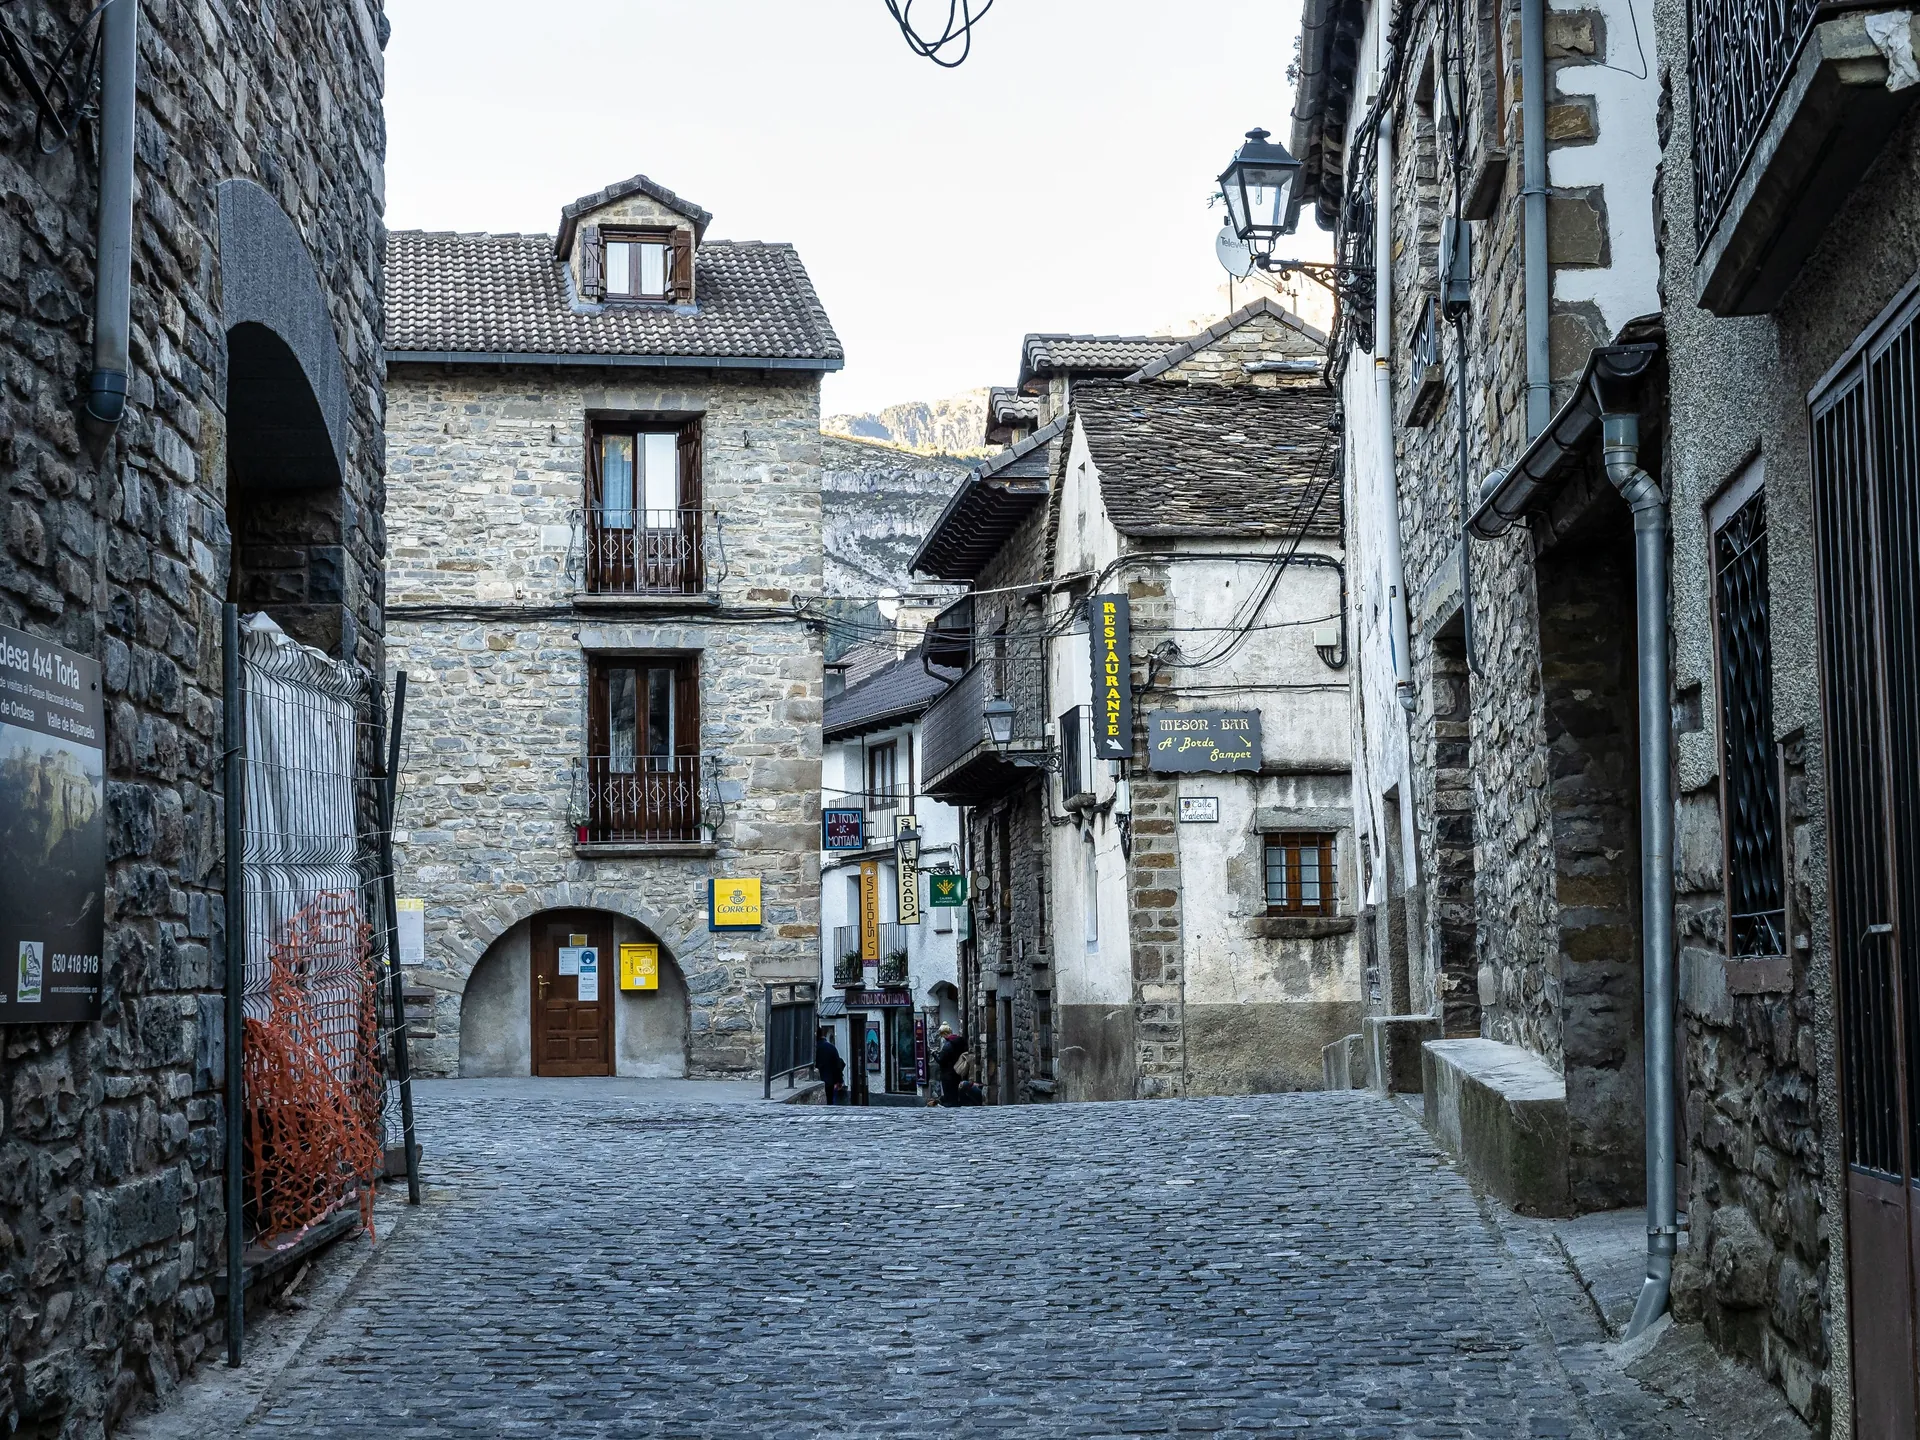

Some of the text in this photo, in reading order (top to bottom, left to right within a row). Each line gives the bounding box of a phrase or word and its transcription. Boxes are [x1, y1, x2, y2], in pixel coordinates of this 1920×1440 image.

[33, 648, 53, 680] 4x4
[55, 655, 80, 690] Torla
[1103, 602, 1120, 736] RESTAURANTE
[7, 680, 22, 693] visitas
[23, 683, 29, 694] al
[29, 685, 45, 701] Parque
[46, 690, 64, 706] Nacional
[65, 697, 70, 709] de
[71, 698, 85, 713] Ordesa
[1, 699, 35, 722] de Ordesa
[47, 711, 95, 739] Valle de Bujaruelo
[1160, 719, 1208, 731] MESON
[1221, 719, 1250, 730] BAR
[1178, 737, 1215, 752] Borda
[1210, 748, 1251, 762] Samper
[1191, 799, 1212, 808] Calle
[827, 813, 837, 824] LA
[717, 903, 758, 914] CORREOS
[867, 875, 875, 938] SPORTIVA
[868, 940, 875, 957] LA
[52, 953, 99, 974] 630 418 918
